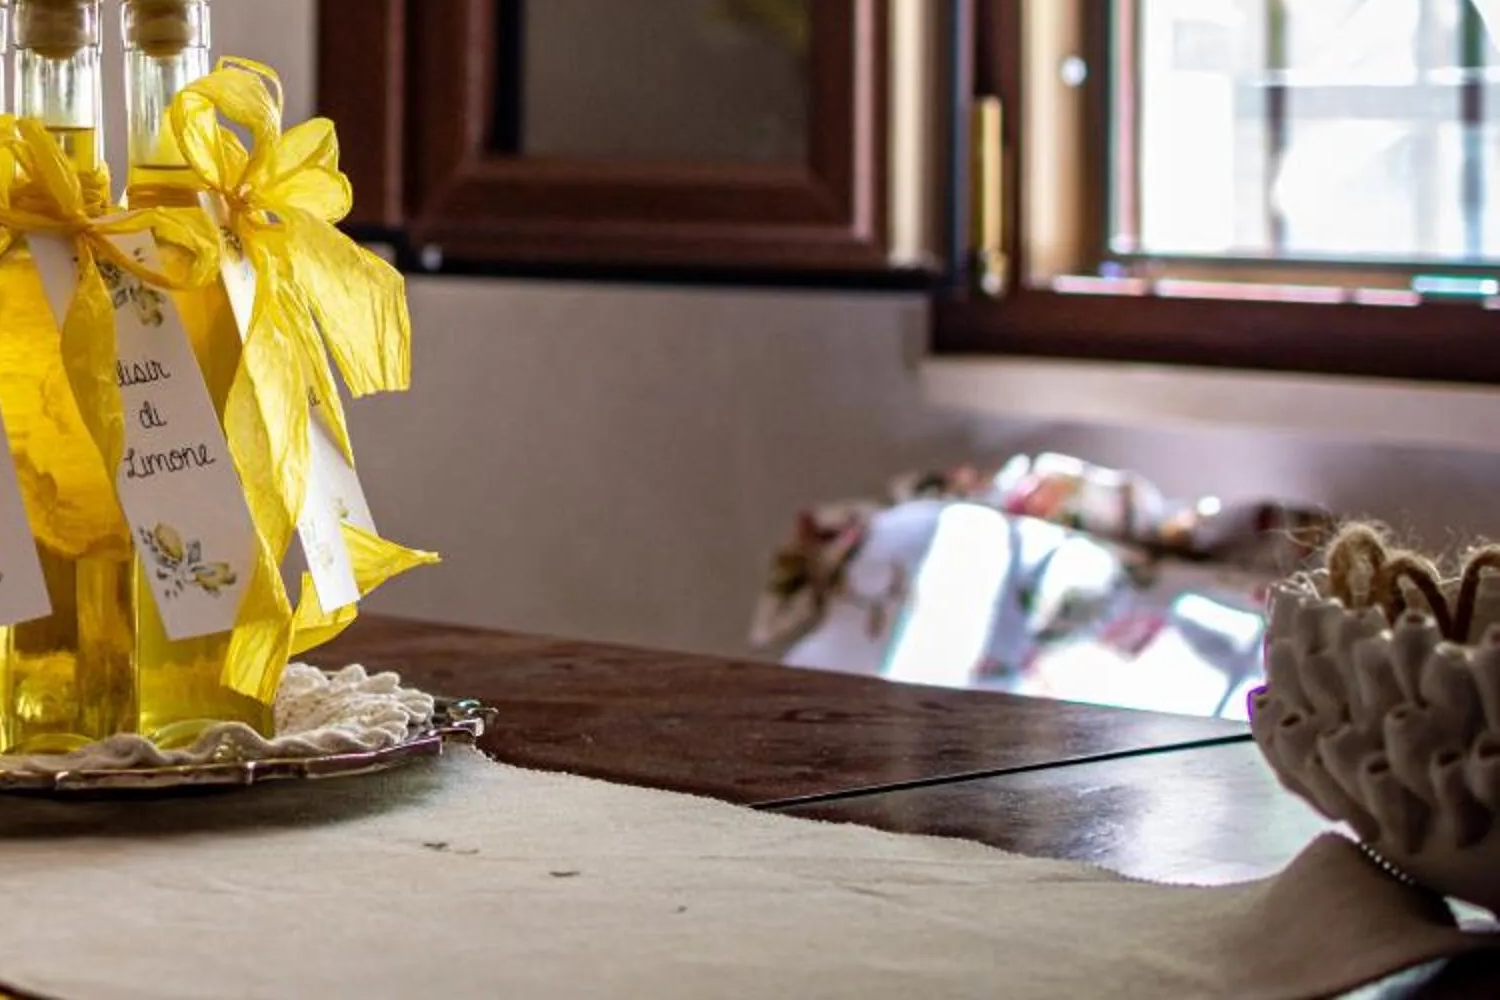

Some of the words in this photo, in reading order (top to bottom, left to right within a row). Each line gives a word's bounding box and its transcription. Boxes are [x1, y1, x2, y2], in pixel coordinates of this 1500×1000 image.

[116, 358, 171, 388] lisir
[139, 400, 168, 429] di
[123, 444, 216, 479] Limone
